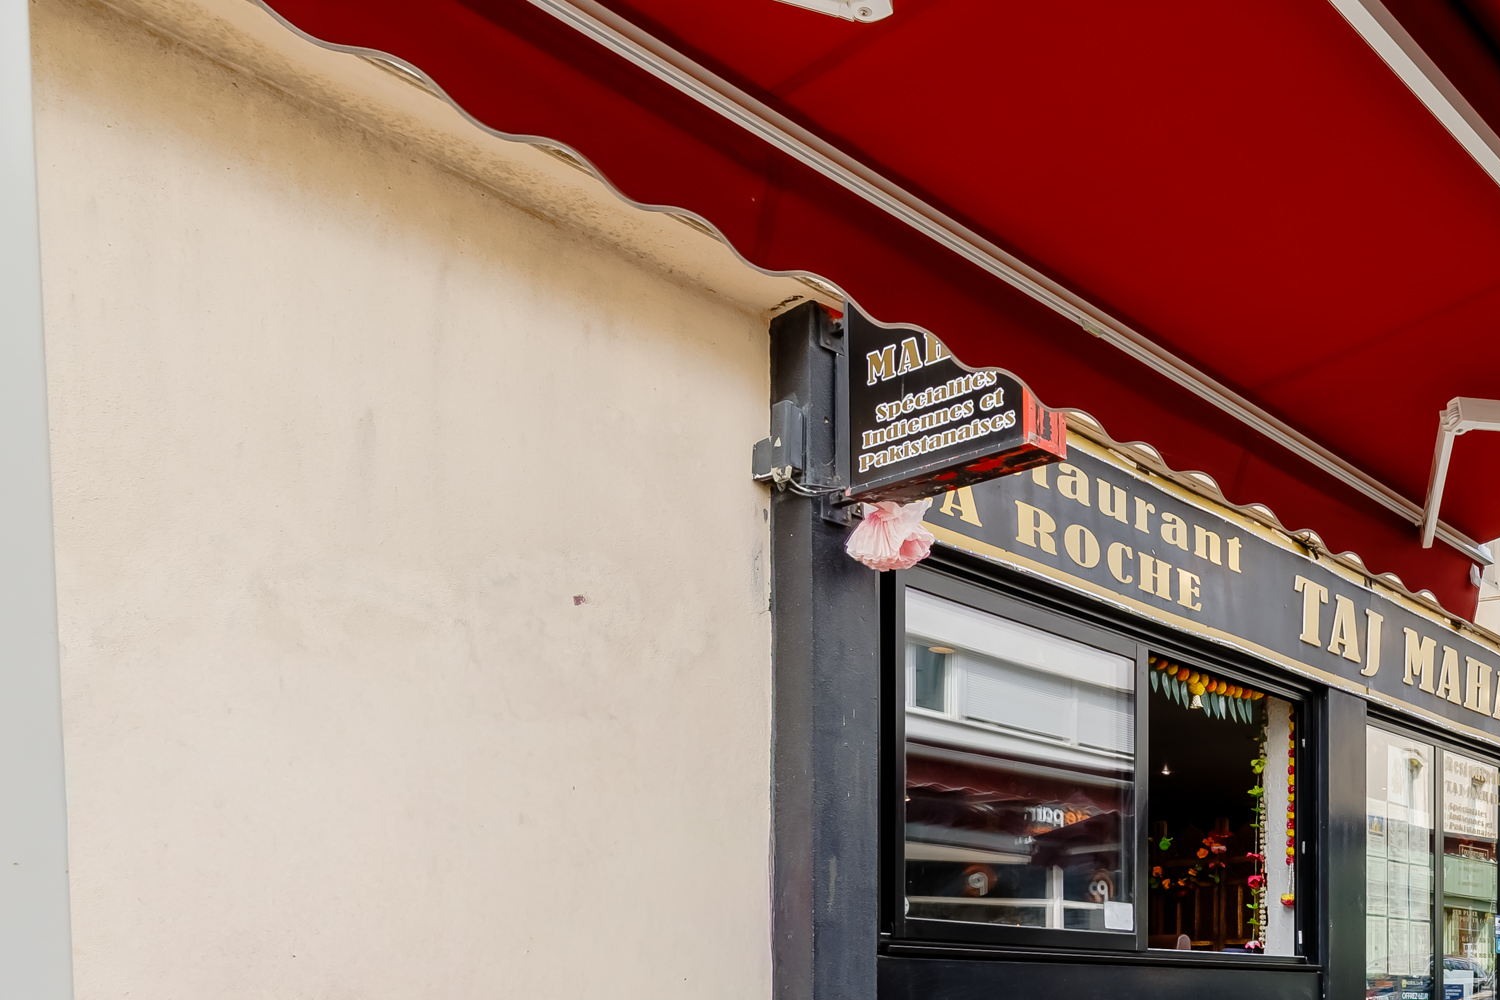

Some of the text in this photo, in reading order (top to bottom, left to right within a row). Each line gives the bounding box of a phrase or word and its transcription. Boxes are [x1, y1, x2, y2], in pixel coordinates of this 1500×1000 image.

[866, 333, 951, 386] MAH
[858, 410, 1016, 473] Pakistanaises
[862, 386, 1004, 449] Indiennes et
[939, 485, 1203, 612] A ROCHE
[1293, 574, 1384, 677] TAJ
